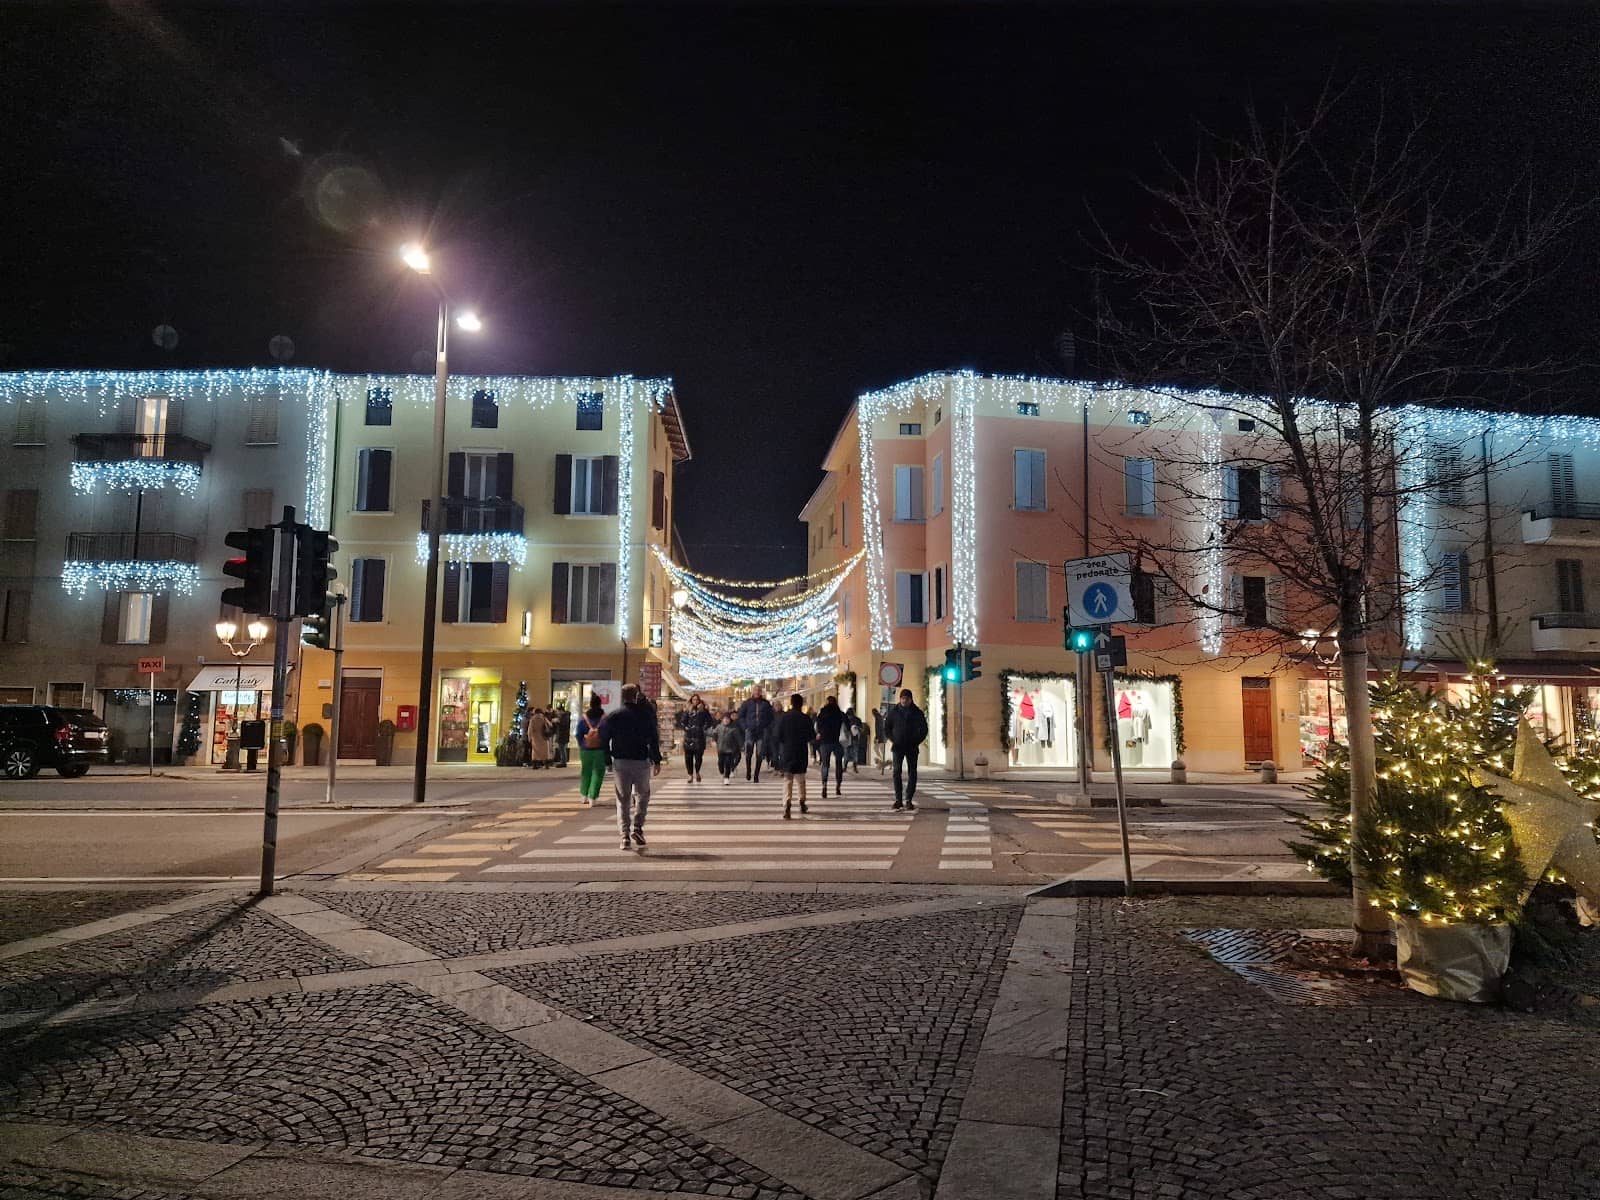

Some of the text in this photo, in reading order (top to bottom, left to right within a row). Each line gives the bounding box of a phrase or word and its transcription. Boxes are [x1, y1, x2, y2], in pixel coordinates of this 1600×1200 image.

[1087, 560, 1107, 568] area
[1076, 566, 1119, 580] pedonale
[141, 661, 161, 669] TAXI
[214, 677, 261, 686] Cafftaly
